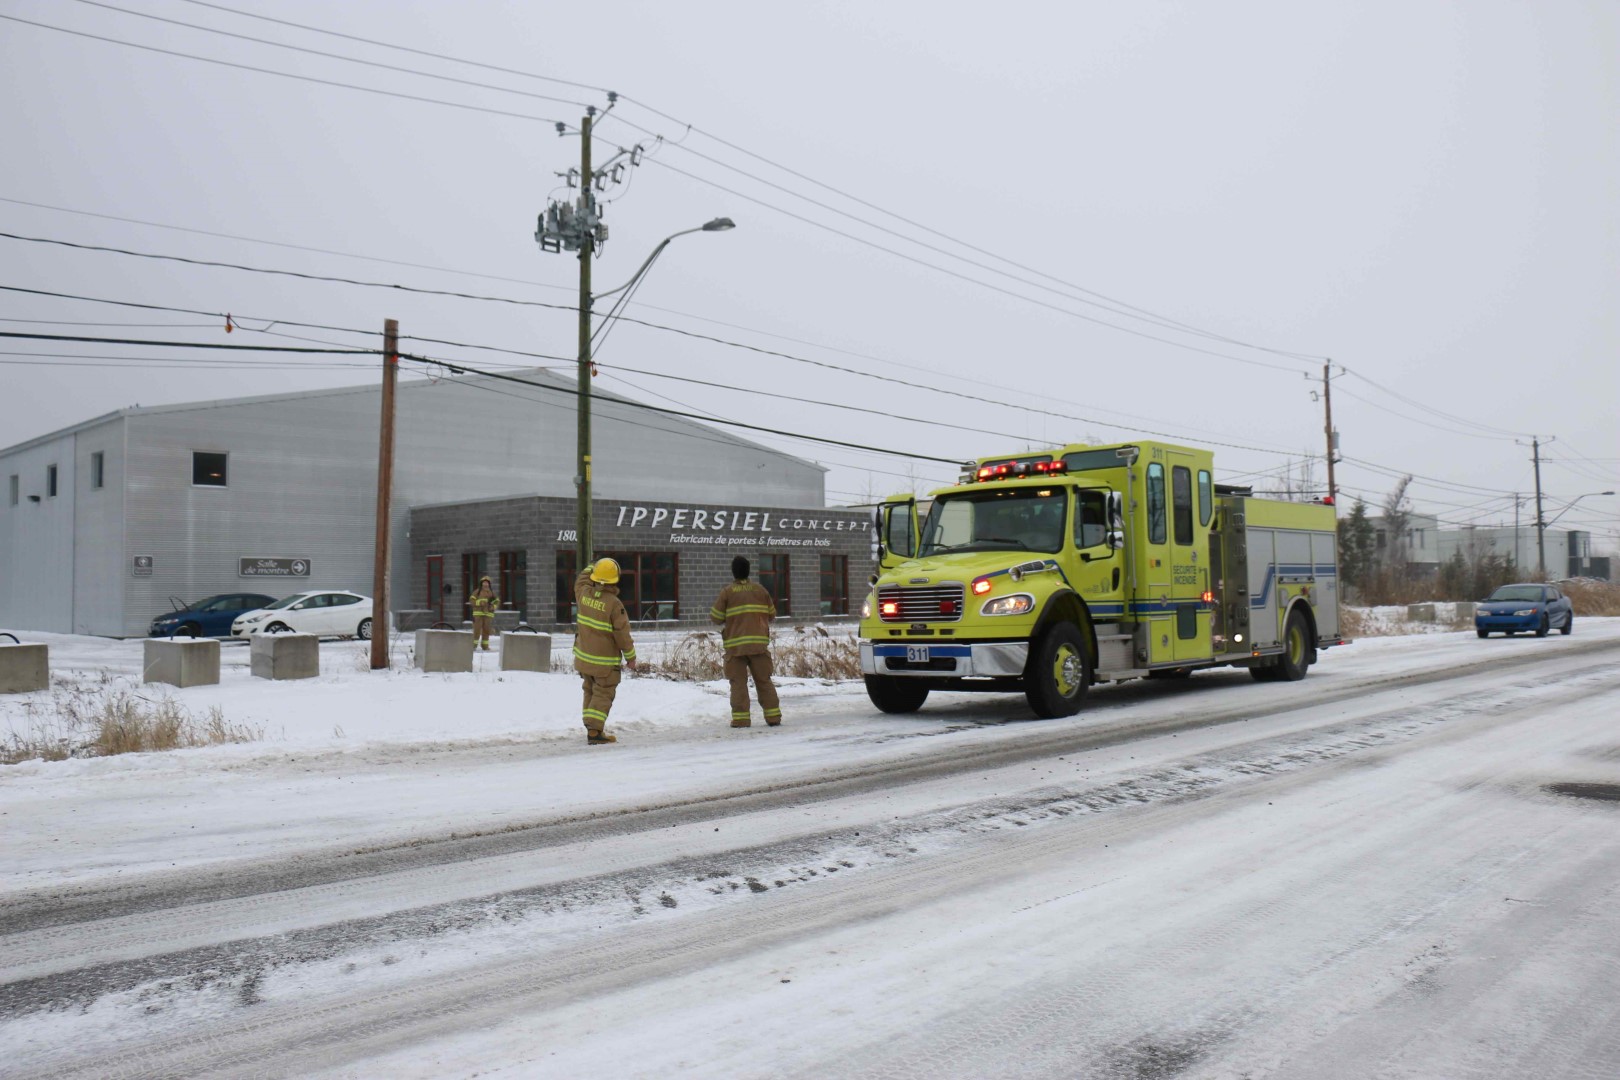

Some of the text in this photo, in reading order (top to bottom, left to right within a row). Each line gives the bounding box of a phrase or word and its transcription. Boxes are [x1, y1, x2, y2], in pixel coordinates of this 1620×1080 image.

[616, 506, 869, 532] IPPERSIEL CONCEPT
[557, 530, 578, 541] 180
[670, 533, 713, 544] Fabricant
[714, 535, 727, 545] de
[728, 537, 757, 547] portes
[758, 537, 765, 545] &
[766, 536, 801, 547] fenêtres
[814, 538, 832, 547] bois
[244, 566, 257, 574] de
[908, 647, 928, 661] 311
